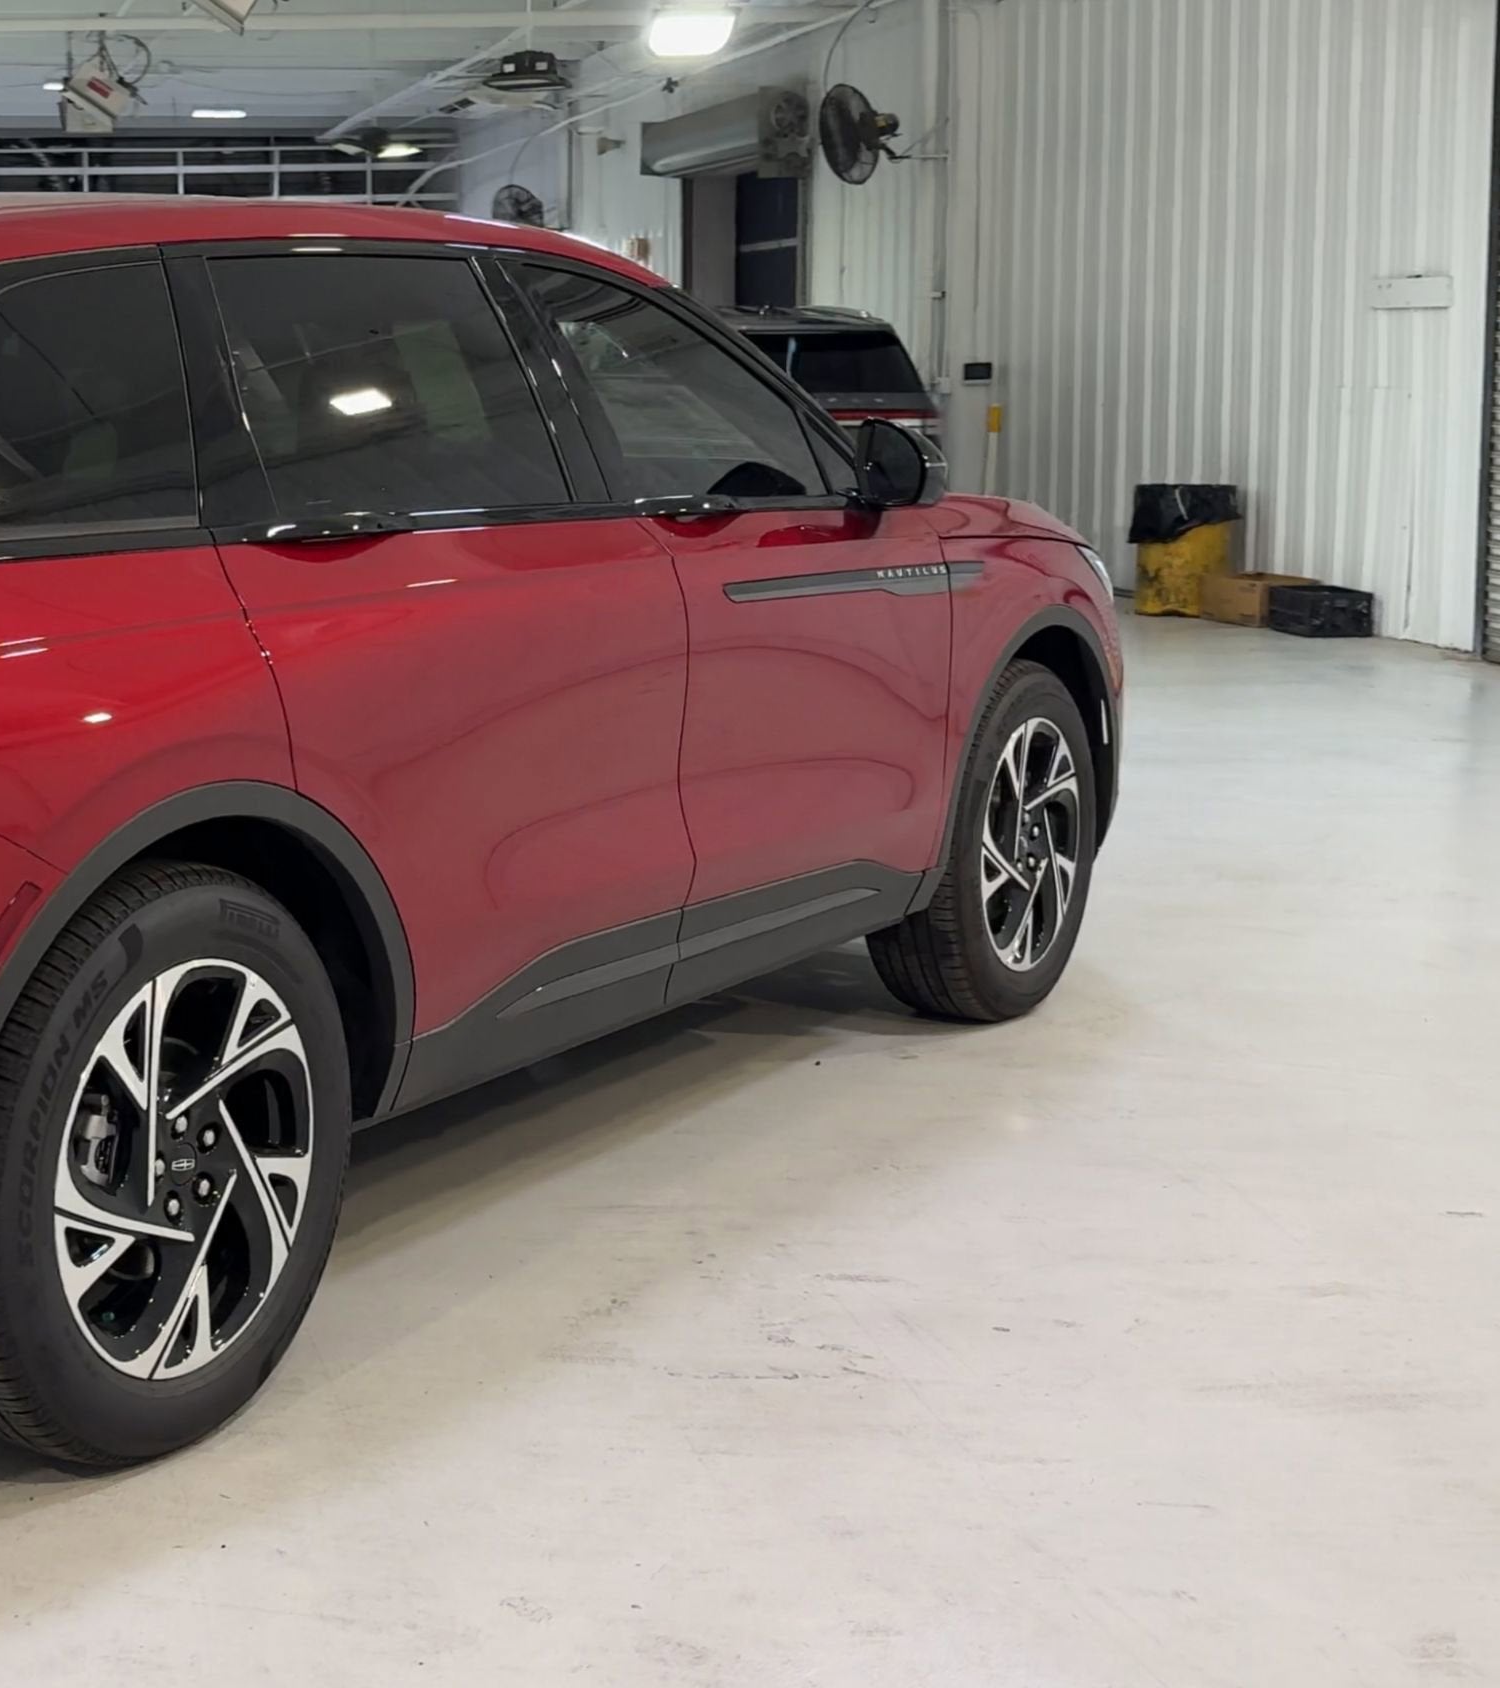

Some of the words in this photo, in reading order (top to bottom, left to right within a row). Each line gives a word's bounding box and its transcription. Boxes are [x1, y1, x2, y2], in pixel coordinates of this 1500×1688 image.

[876, 565, 947, 578] NAUTILUS
[17, 1032, 72, 1268] SCORPION
[72, 969, 109, 1028] MS
